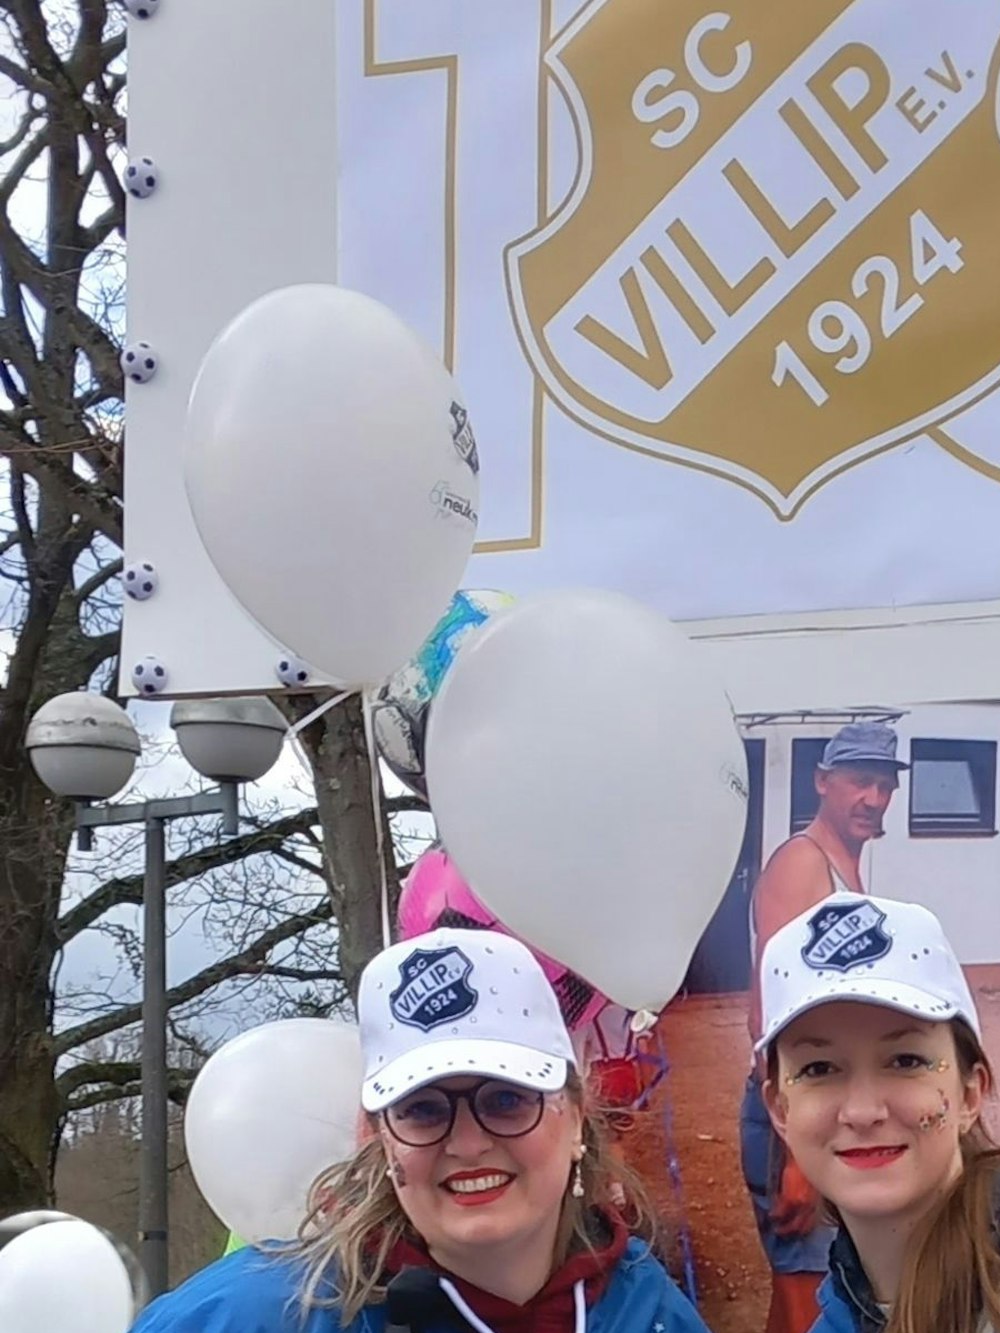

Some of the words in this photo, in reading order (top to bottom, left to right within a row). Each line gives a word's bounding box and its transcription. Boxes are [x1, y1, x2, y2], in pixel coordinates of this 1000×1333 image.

[631, 11, 752, 149] SC
[573, 41, 892, 392] VILLIP
[895, 49, 975, 134] E.V.
[770, 207, 965, 407] 1924
[812, 914, 863, 961] VILLIP
[817, 911, 840, 932] SC
[407, 957, 429, 978] SC
[839, 935, 874, 961] 1924
[396, 963, 448, 1015] VILLIP
[423, 988, 459, 1017] 1924
